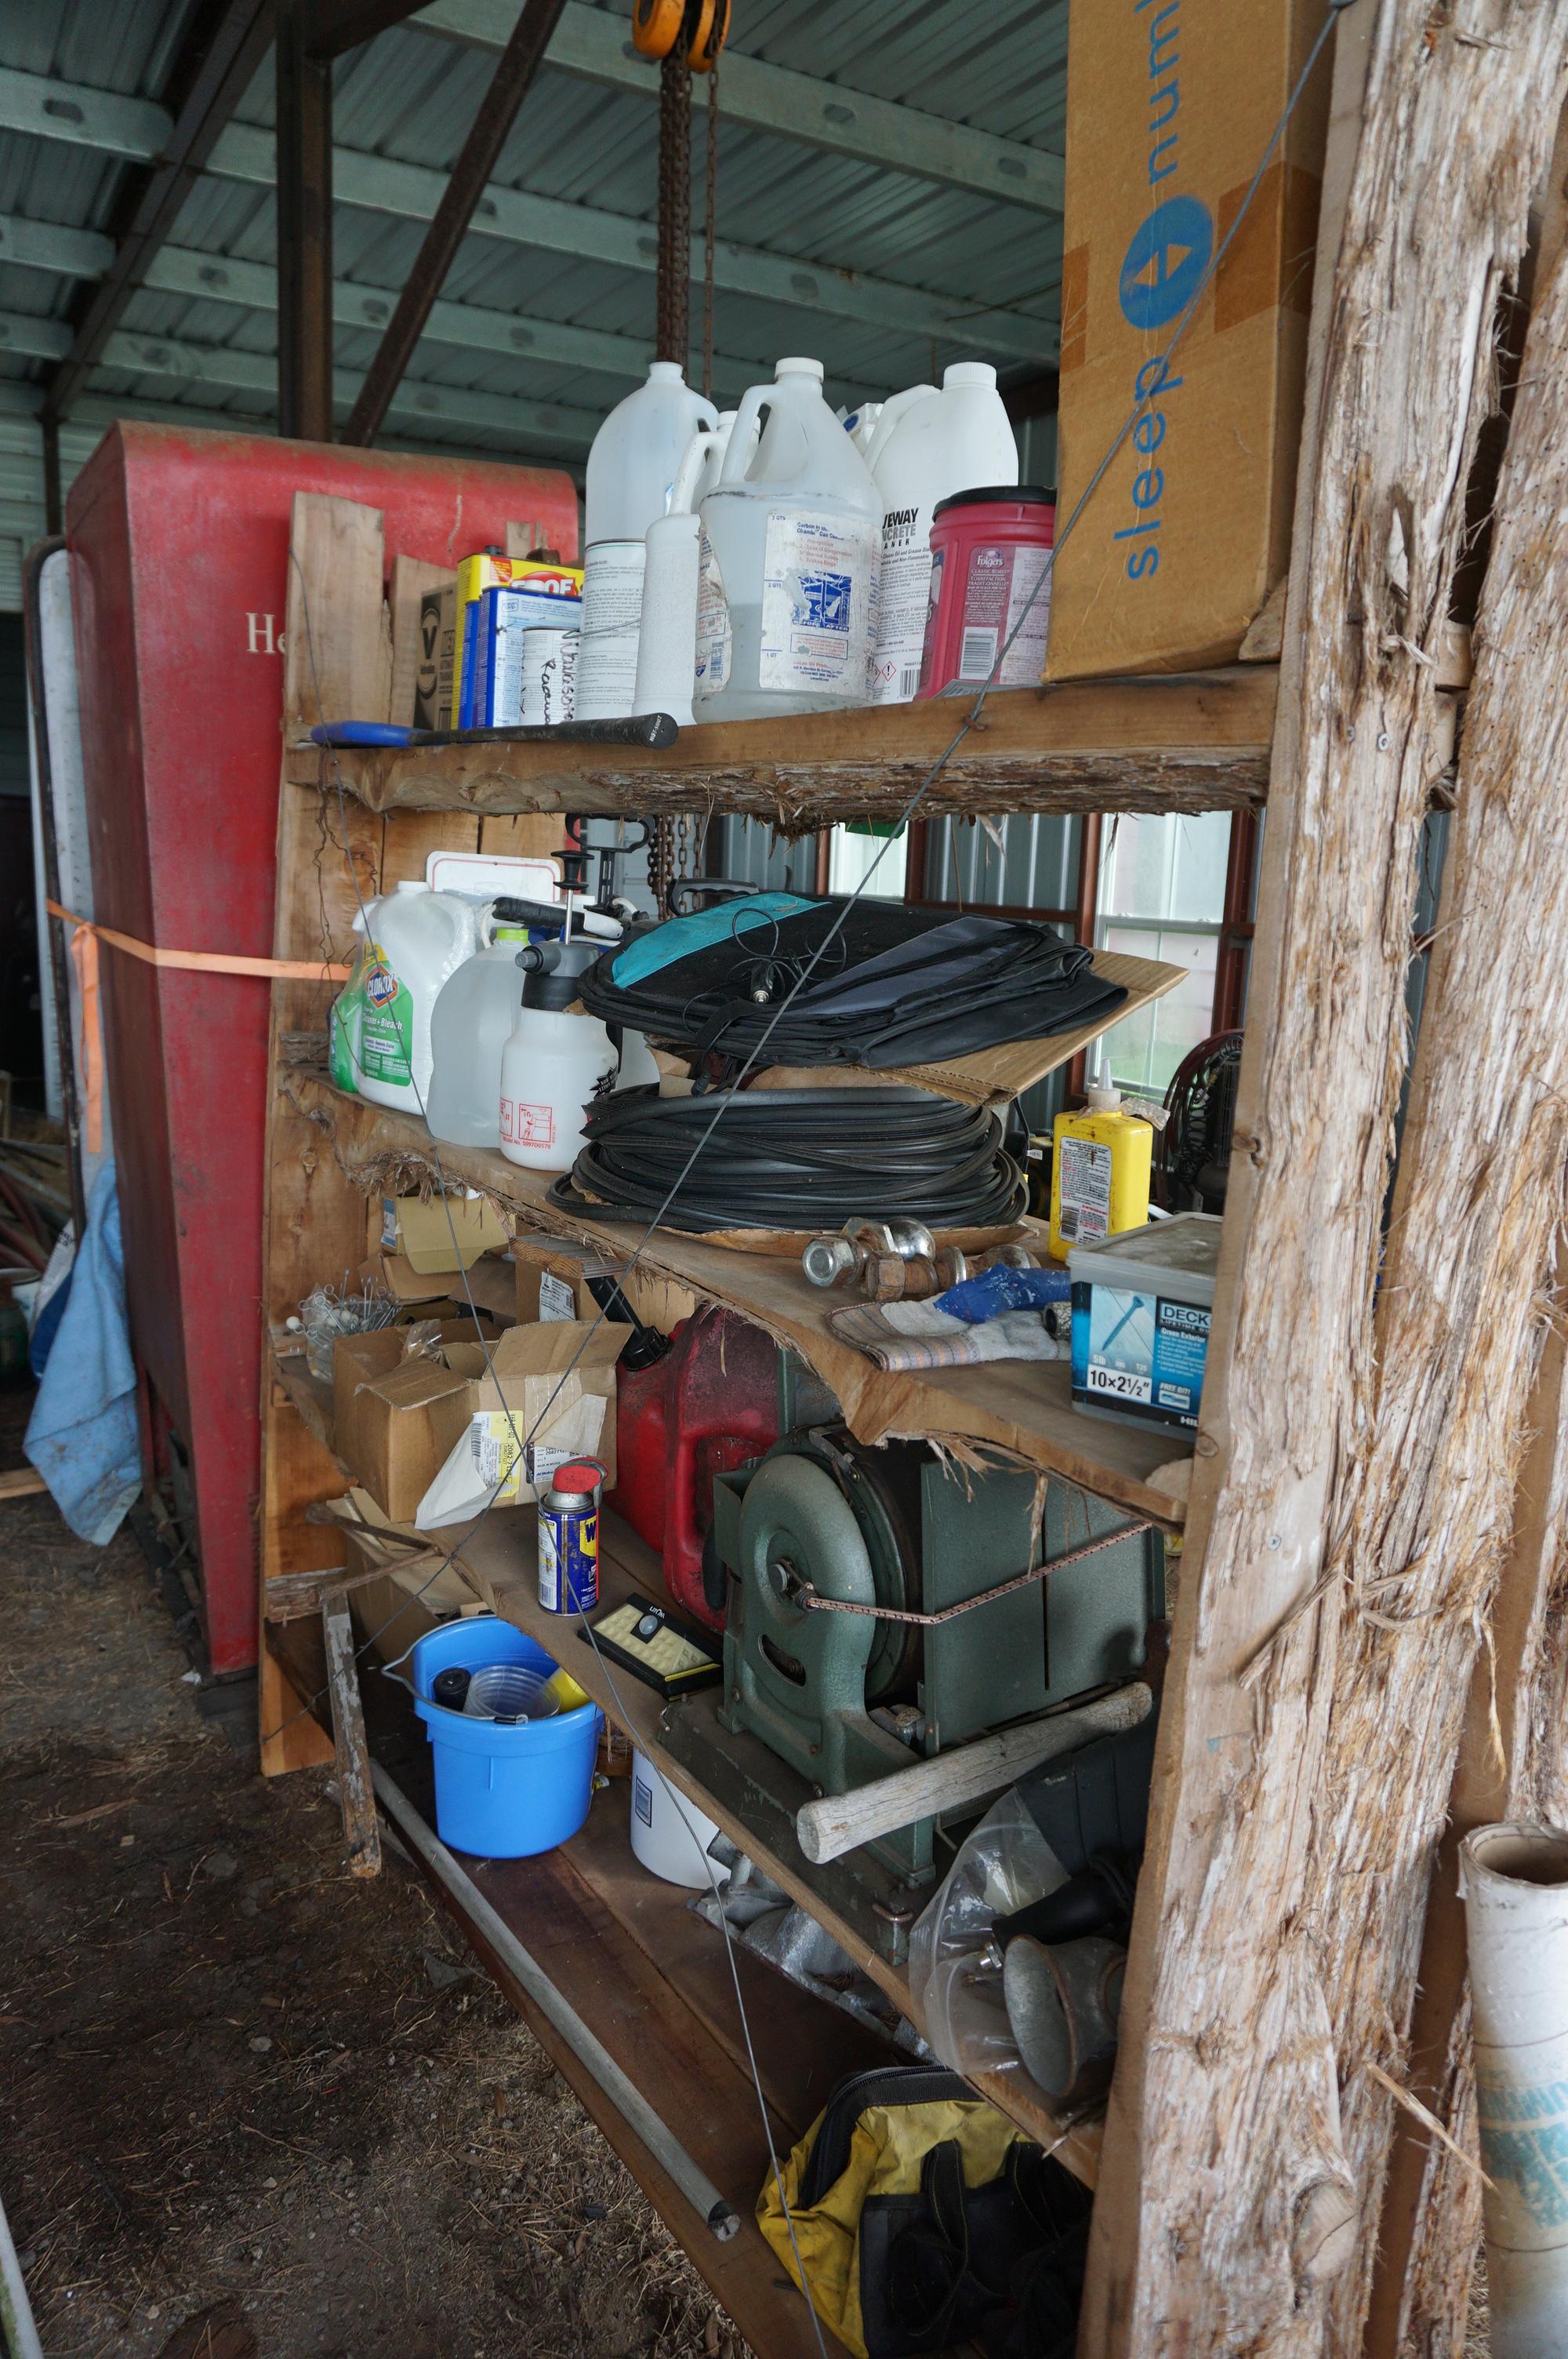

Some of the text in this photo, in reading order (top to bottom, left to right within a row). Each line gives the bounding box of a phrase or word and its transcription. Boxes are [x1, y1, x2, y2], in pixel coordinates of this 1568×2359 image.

[1113, 0, 1183, 580] sleep num
[977, 554, 1004, 568] Folgers
[368, 973, 395, 998] CLOROX
[1164, 1307, 1209, 1325] DECK
[1181, 1331, 1206, 1343] Exterior
[1093, 1354, 1106, 1365] 5lb
